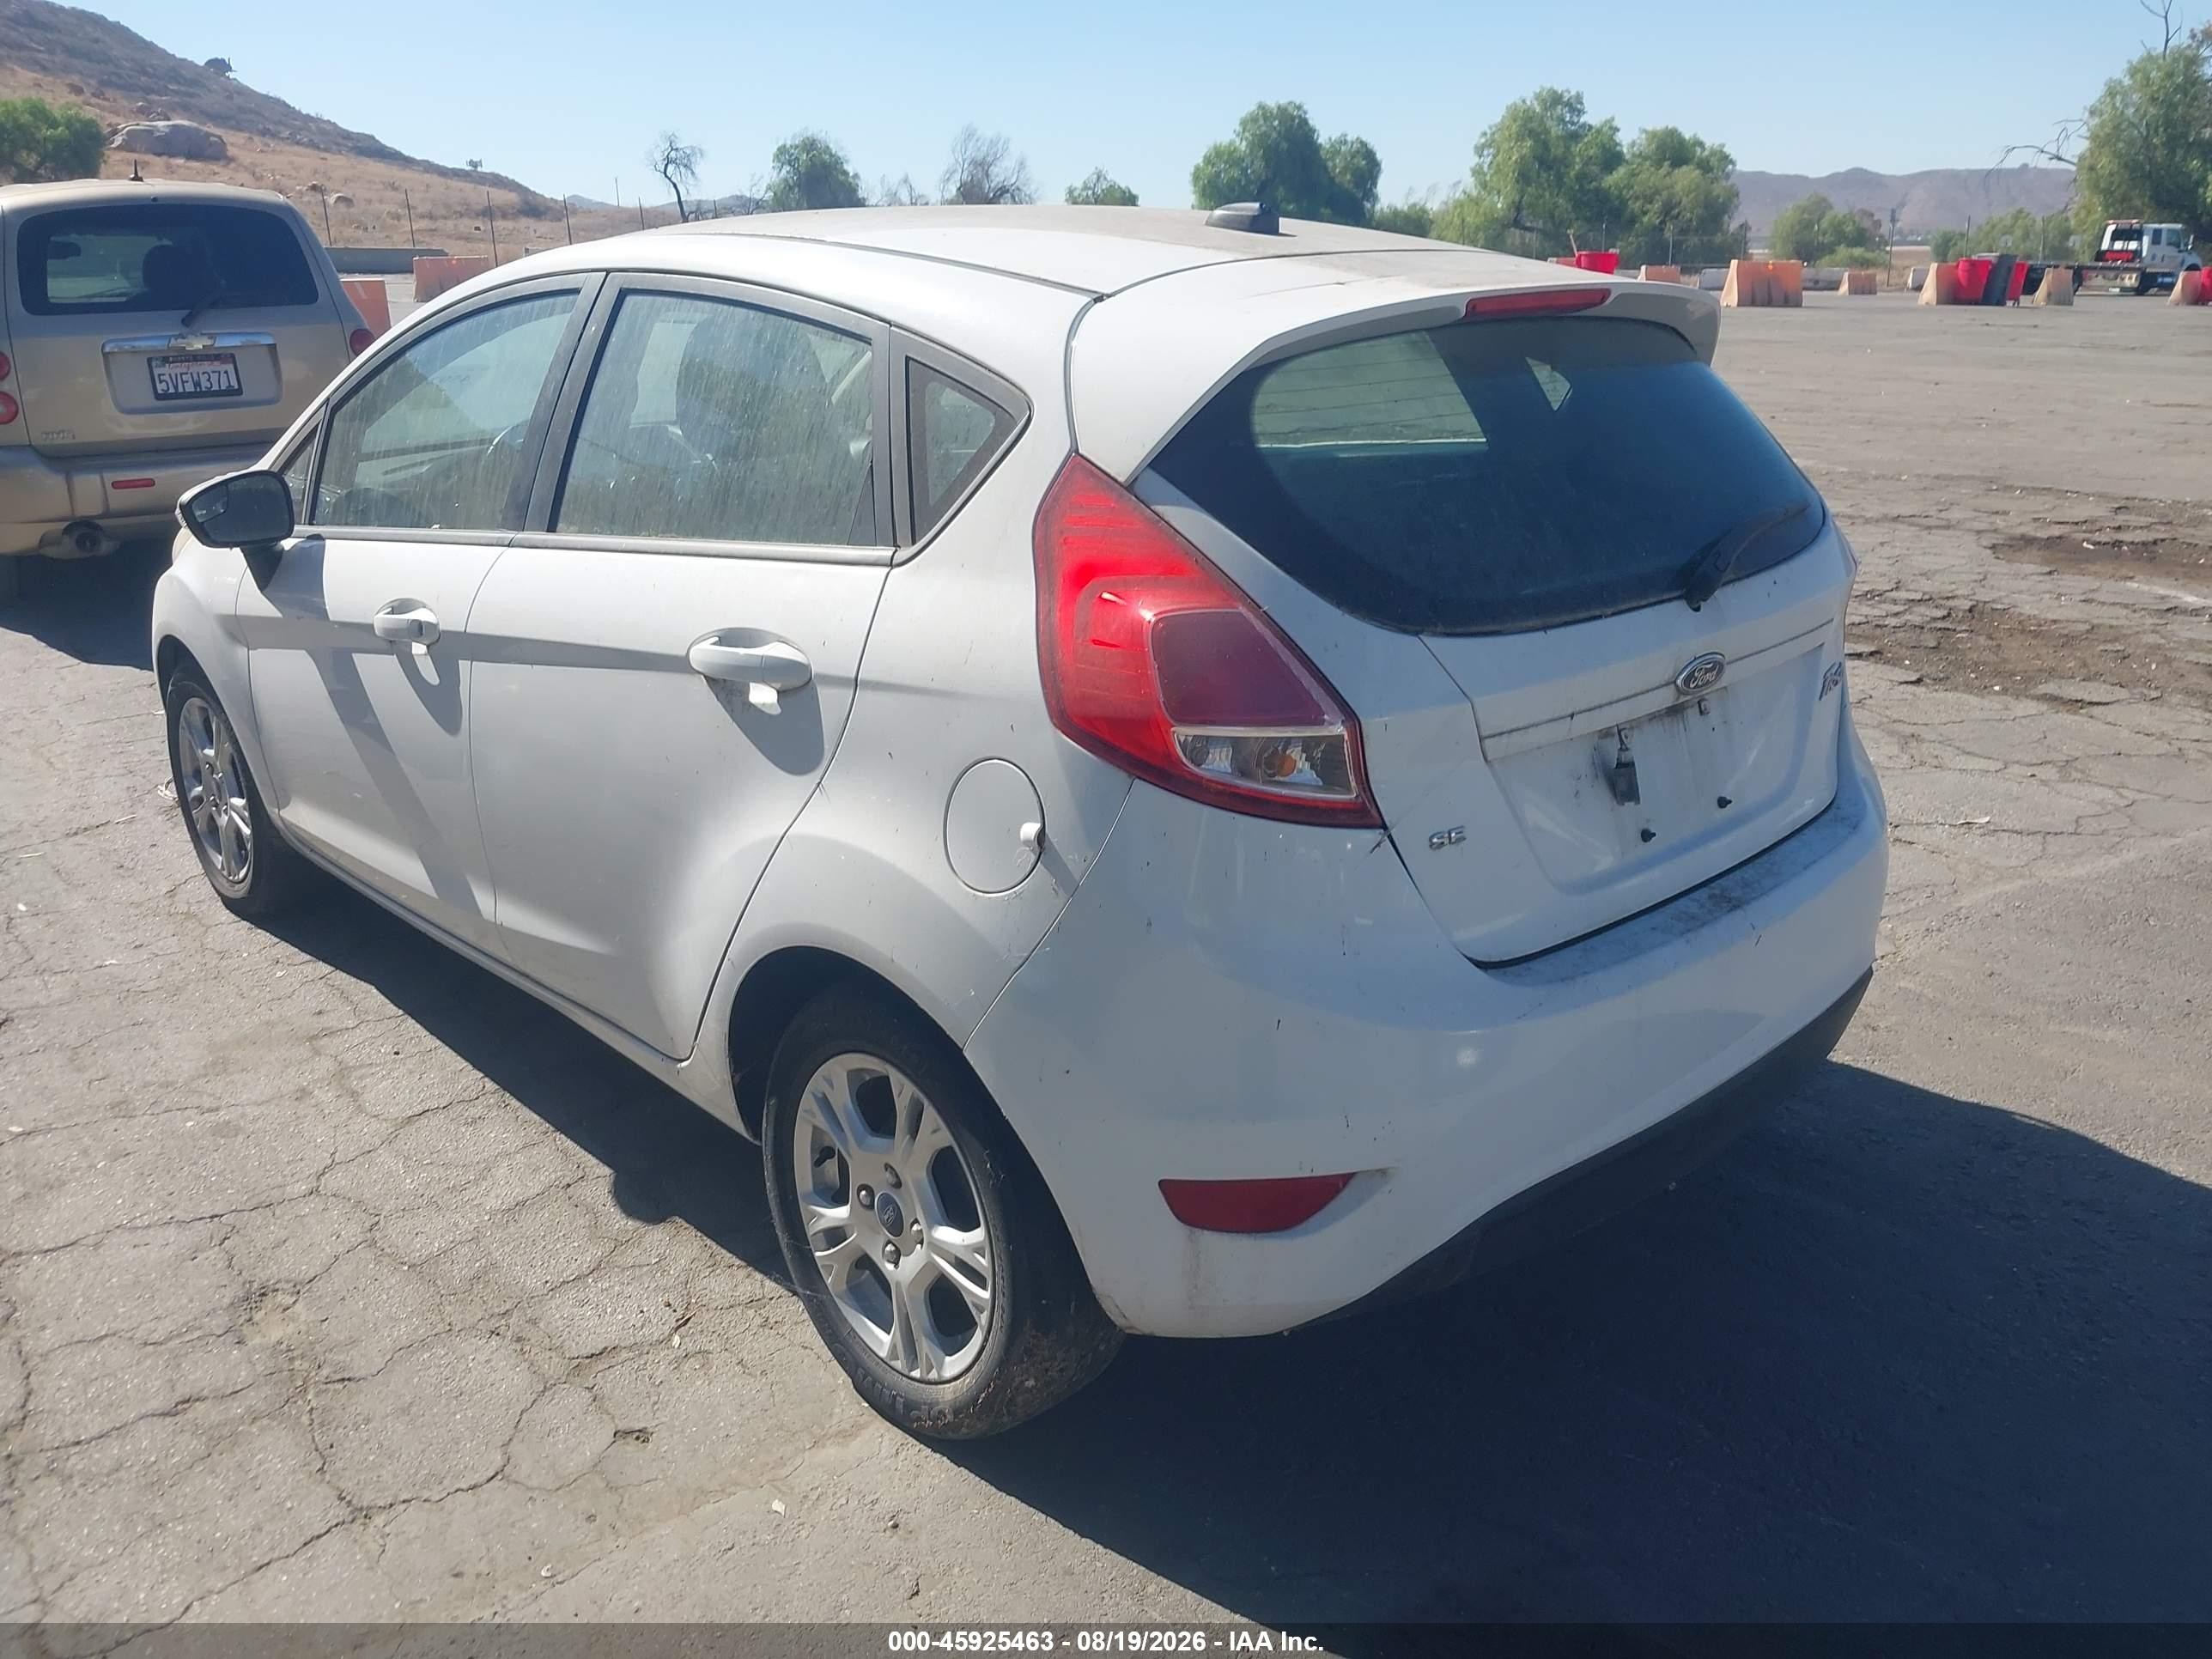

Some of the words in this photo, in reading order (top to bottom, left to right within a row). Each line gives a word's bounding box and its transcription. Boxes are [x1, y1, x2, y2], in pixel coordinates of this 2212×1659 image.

[157, 370, 236, 392] 5VFW371
[1689, 662, 1719, 689] Ford
[1429, 825, 1465, 850] SE
